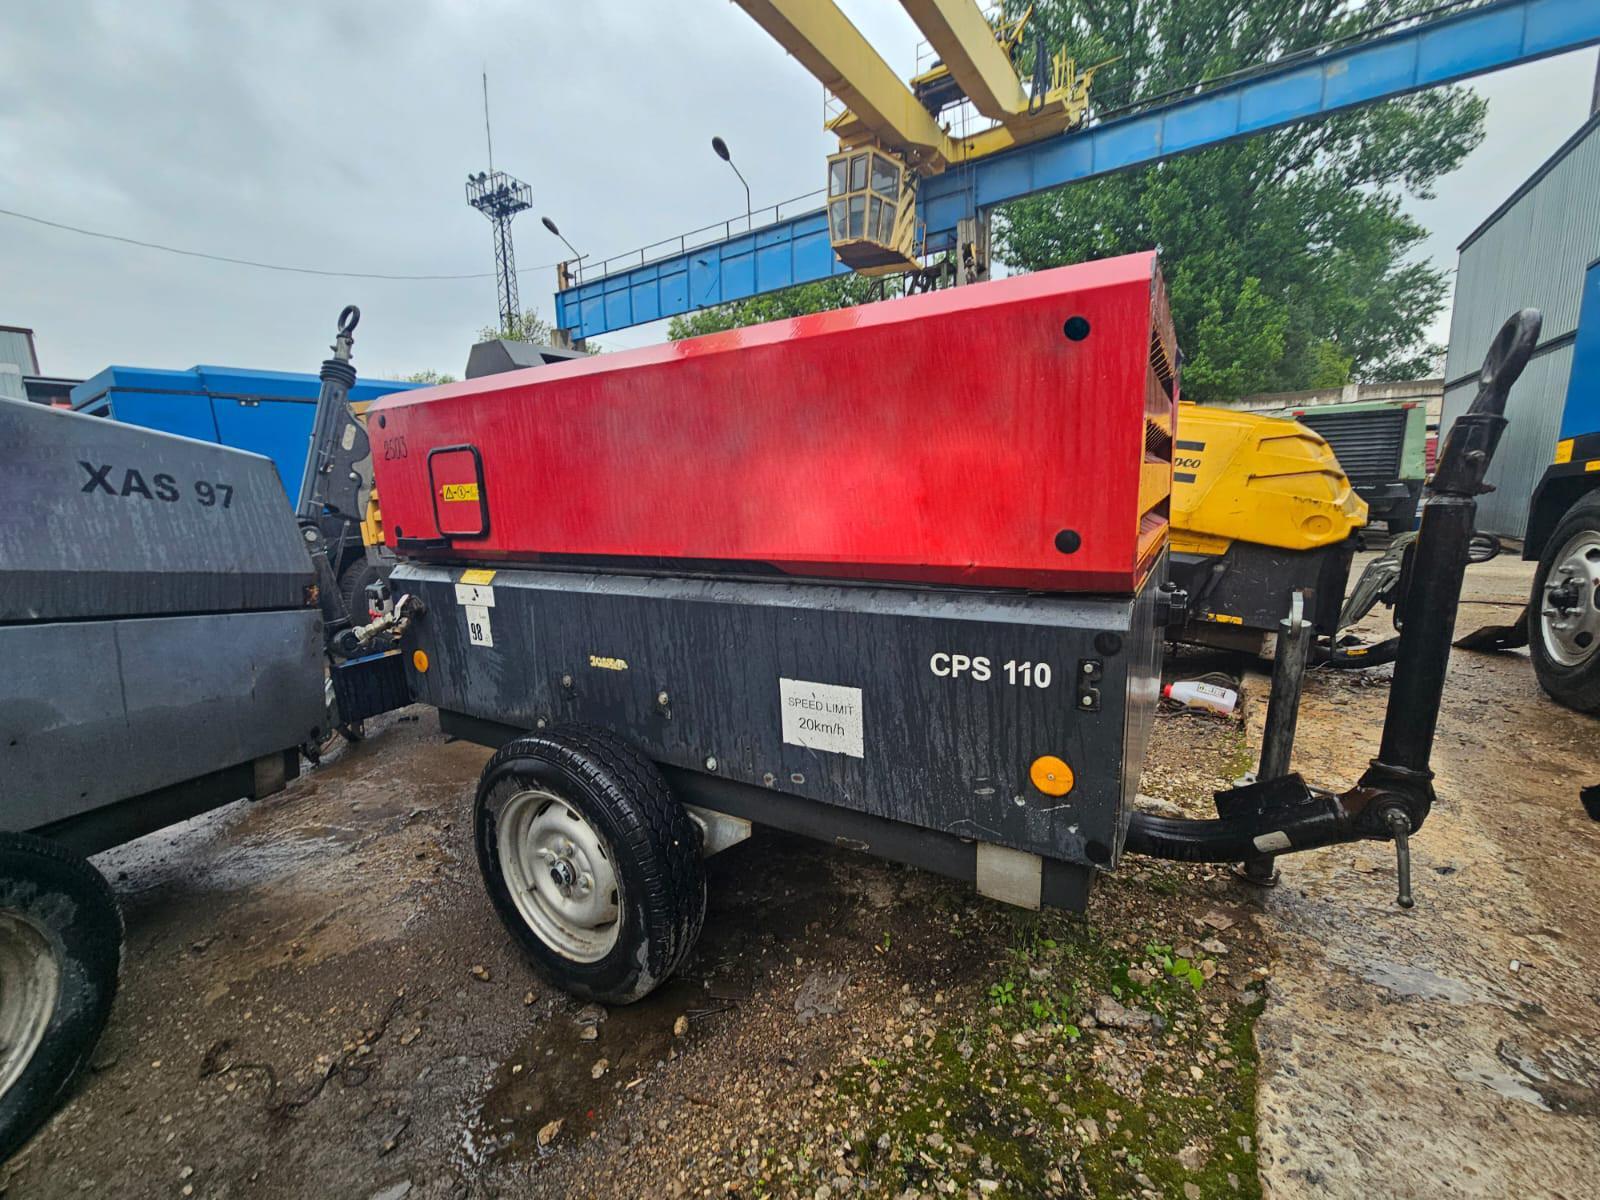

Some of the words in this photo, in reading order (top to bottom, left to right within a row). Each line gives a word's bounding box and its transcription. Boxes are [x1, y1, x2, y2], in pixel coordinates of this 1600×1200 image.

[78, 460, 181, 503] XAS
[194, 480, 234, 509] 97
[470, 622, 483, 641] 98
[929, 652, 992, 682] CPS
[1003, 660, 1052, 689] 110
[788, 696, 823, 712] SPEED
[826, 702, 854, 716] LIMIT
[798, 717, 845, 736] 20km/h
